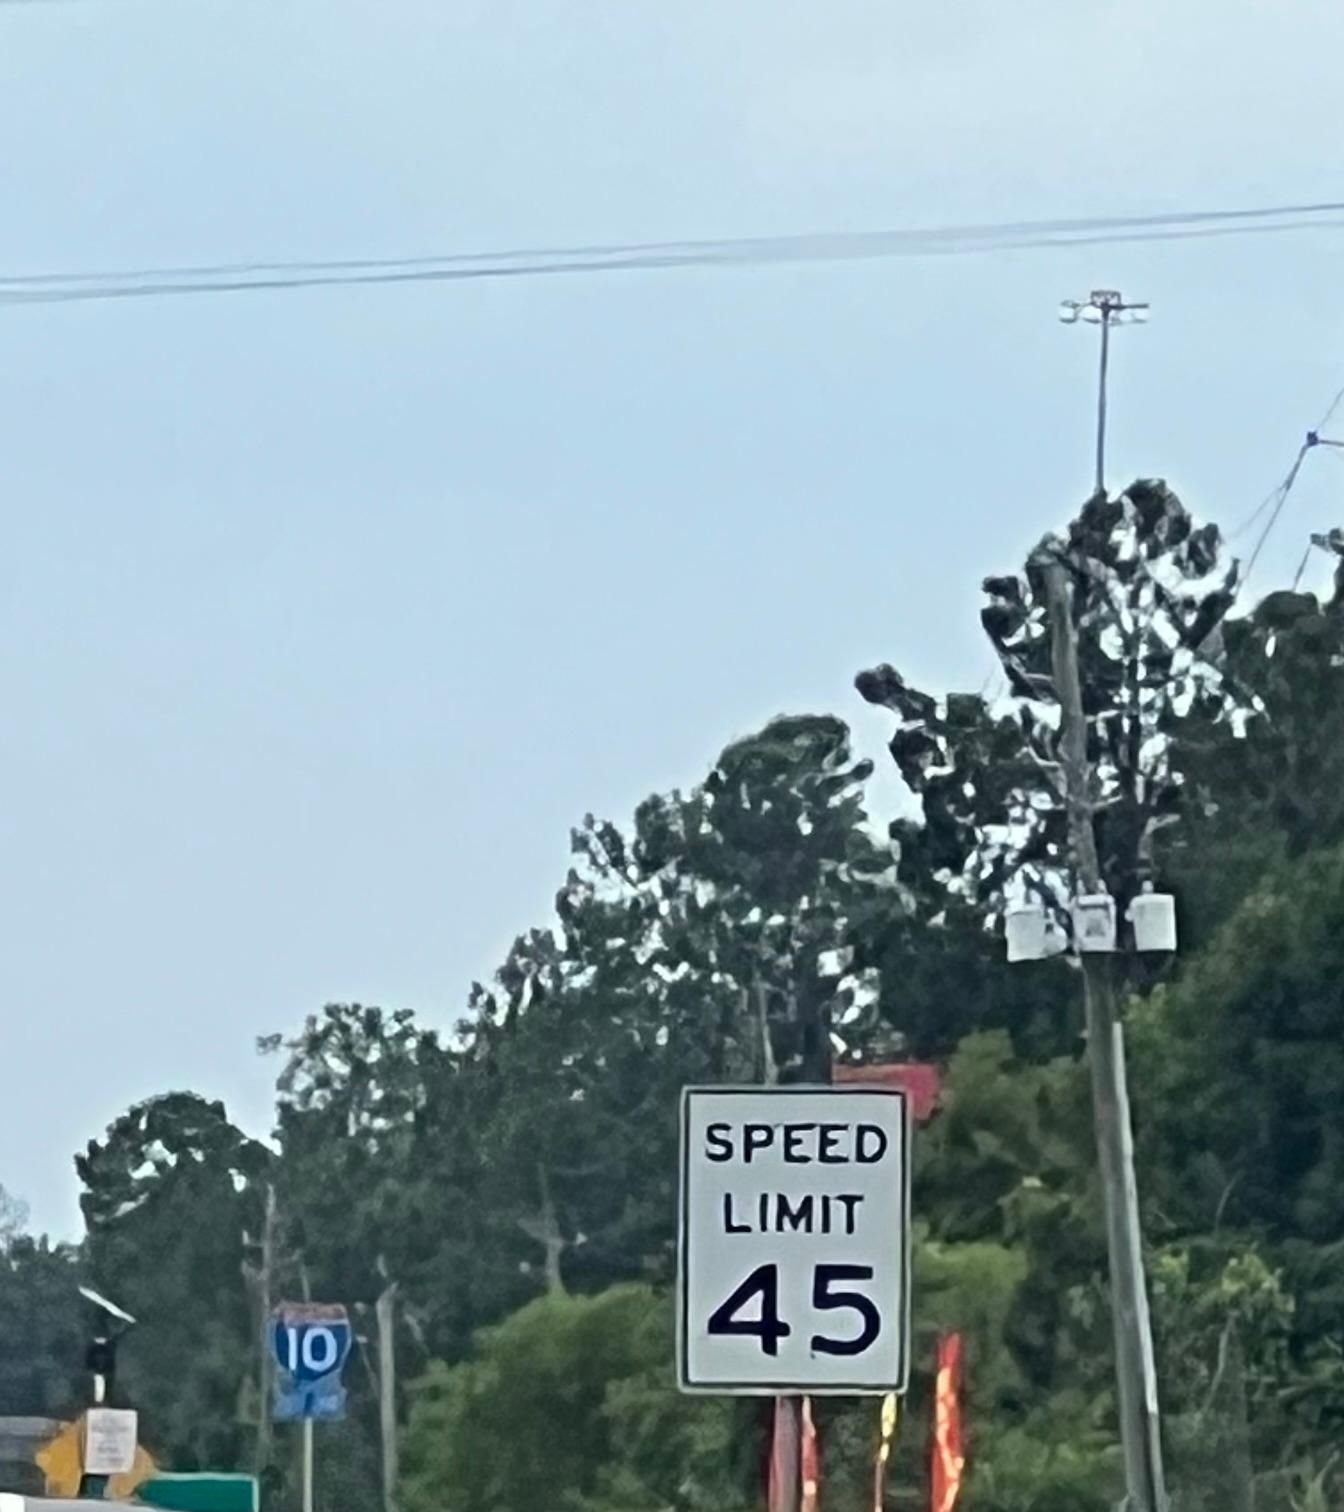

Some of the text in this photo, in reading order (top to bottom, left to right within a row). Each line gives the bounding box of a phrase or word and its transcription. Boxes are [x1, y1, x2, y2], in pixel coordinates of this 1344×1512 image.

[706, 1123, 887, 1163] SPEED
[724, 1192, 864, 1234] LIMIT
[708, 1263, 880, 1356] 45
[287, 1327, 337, 1371] 10
